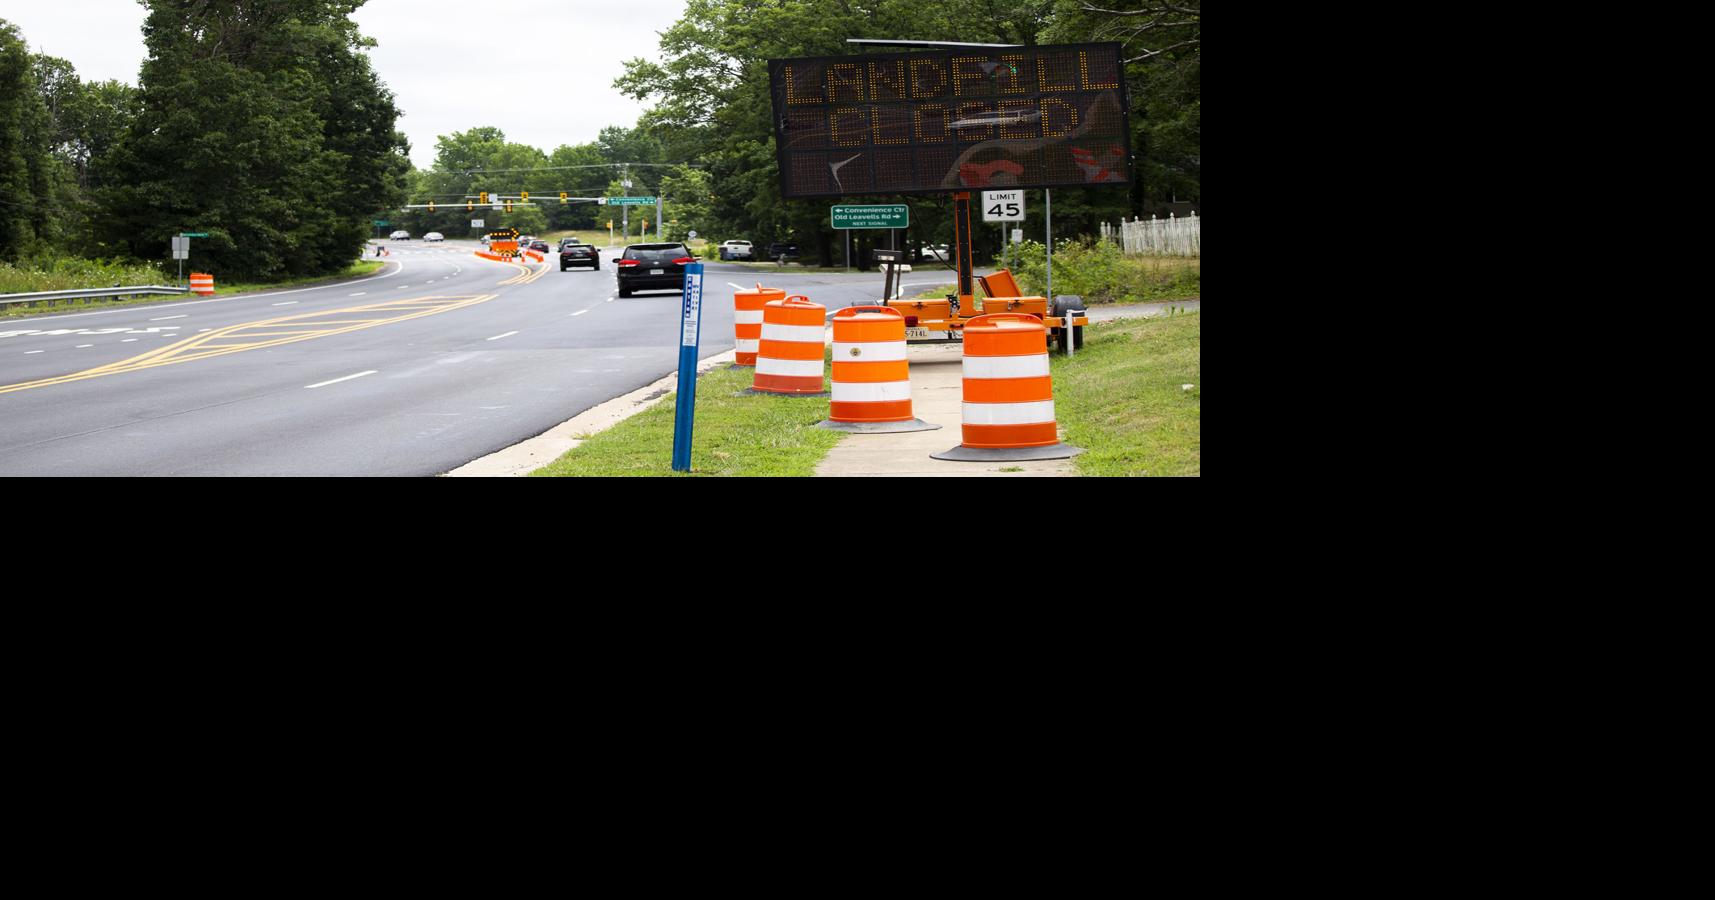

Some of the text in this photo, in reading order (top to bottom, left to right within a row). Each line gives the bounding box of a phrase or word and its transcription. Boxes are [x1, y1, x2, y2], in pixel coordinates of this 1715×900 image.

[785, 51, 1119, 105] LANDFILL
[830, 97, 1079, 147] CLOSED
[987, 202, 1020, 217] 45
[989, 193, 1017, 201] LIMIT
